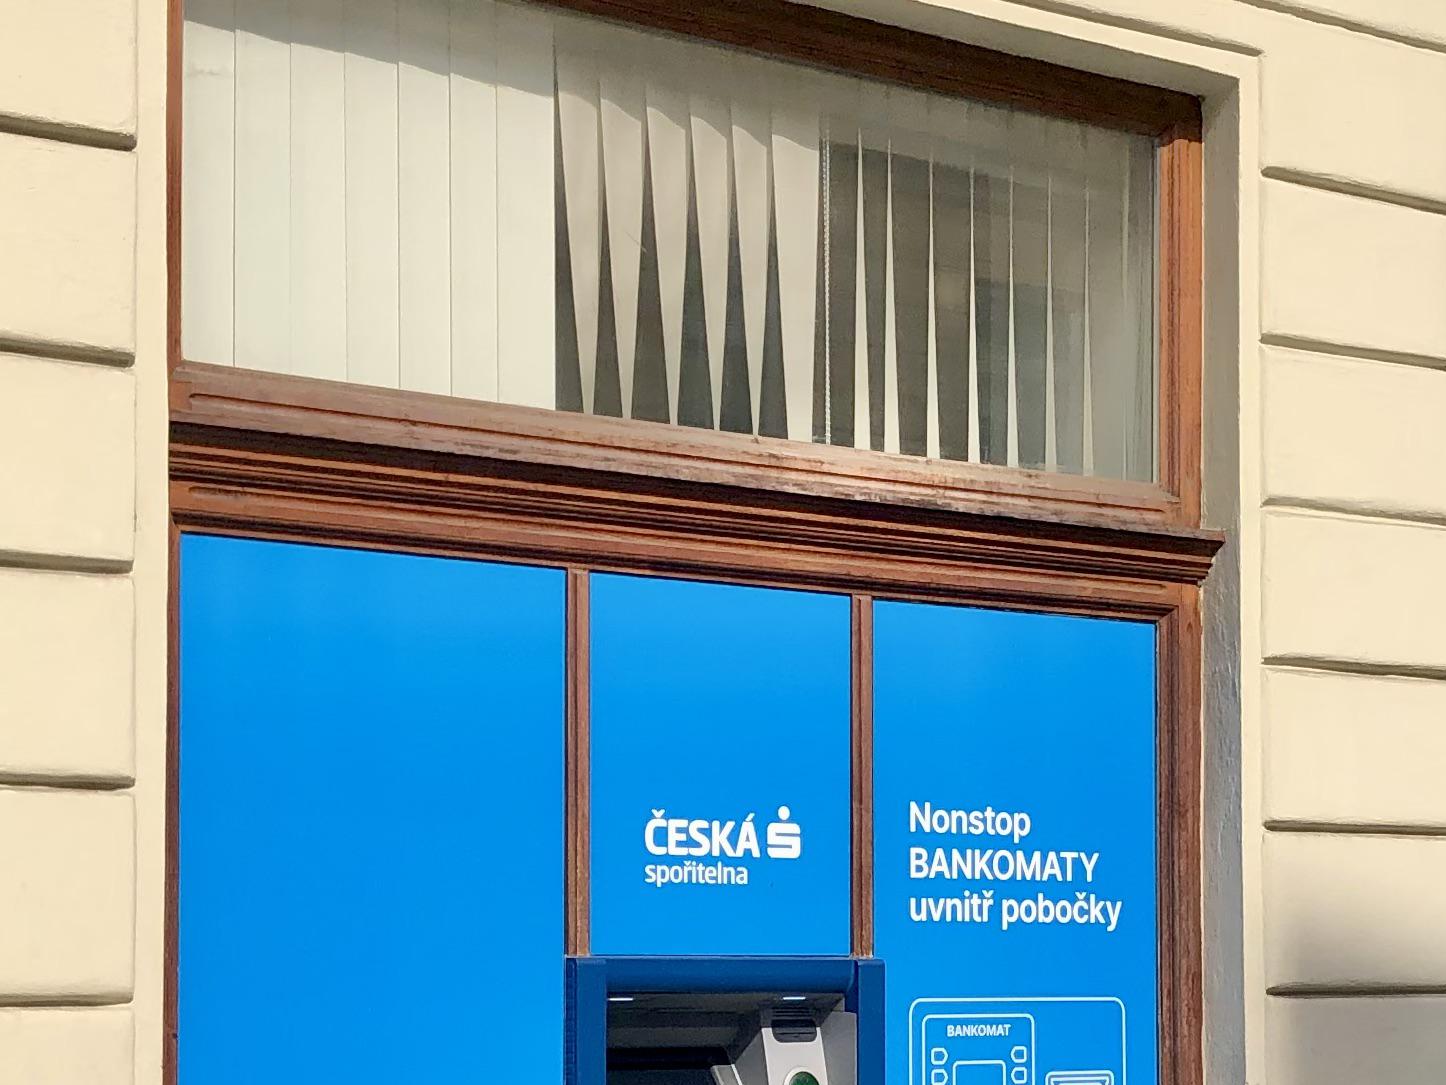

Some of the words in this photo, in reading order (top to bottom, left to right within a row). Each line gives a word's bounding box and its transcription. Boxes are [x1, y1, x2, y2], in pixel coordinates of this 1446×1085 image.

[644, 809, 760, 858] ČESKÁ
[909, 801, 1031, 843] Nonstop
[644, 860, 748, 888] spořitelna
[909, 847, 1099, 882] BANKOMATY
[909, 890, 994, 923] uvnitř
[1001, 891, 1122, 932] pobočky
[946, 1024, 1011, 1038] BANKOMAT
